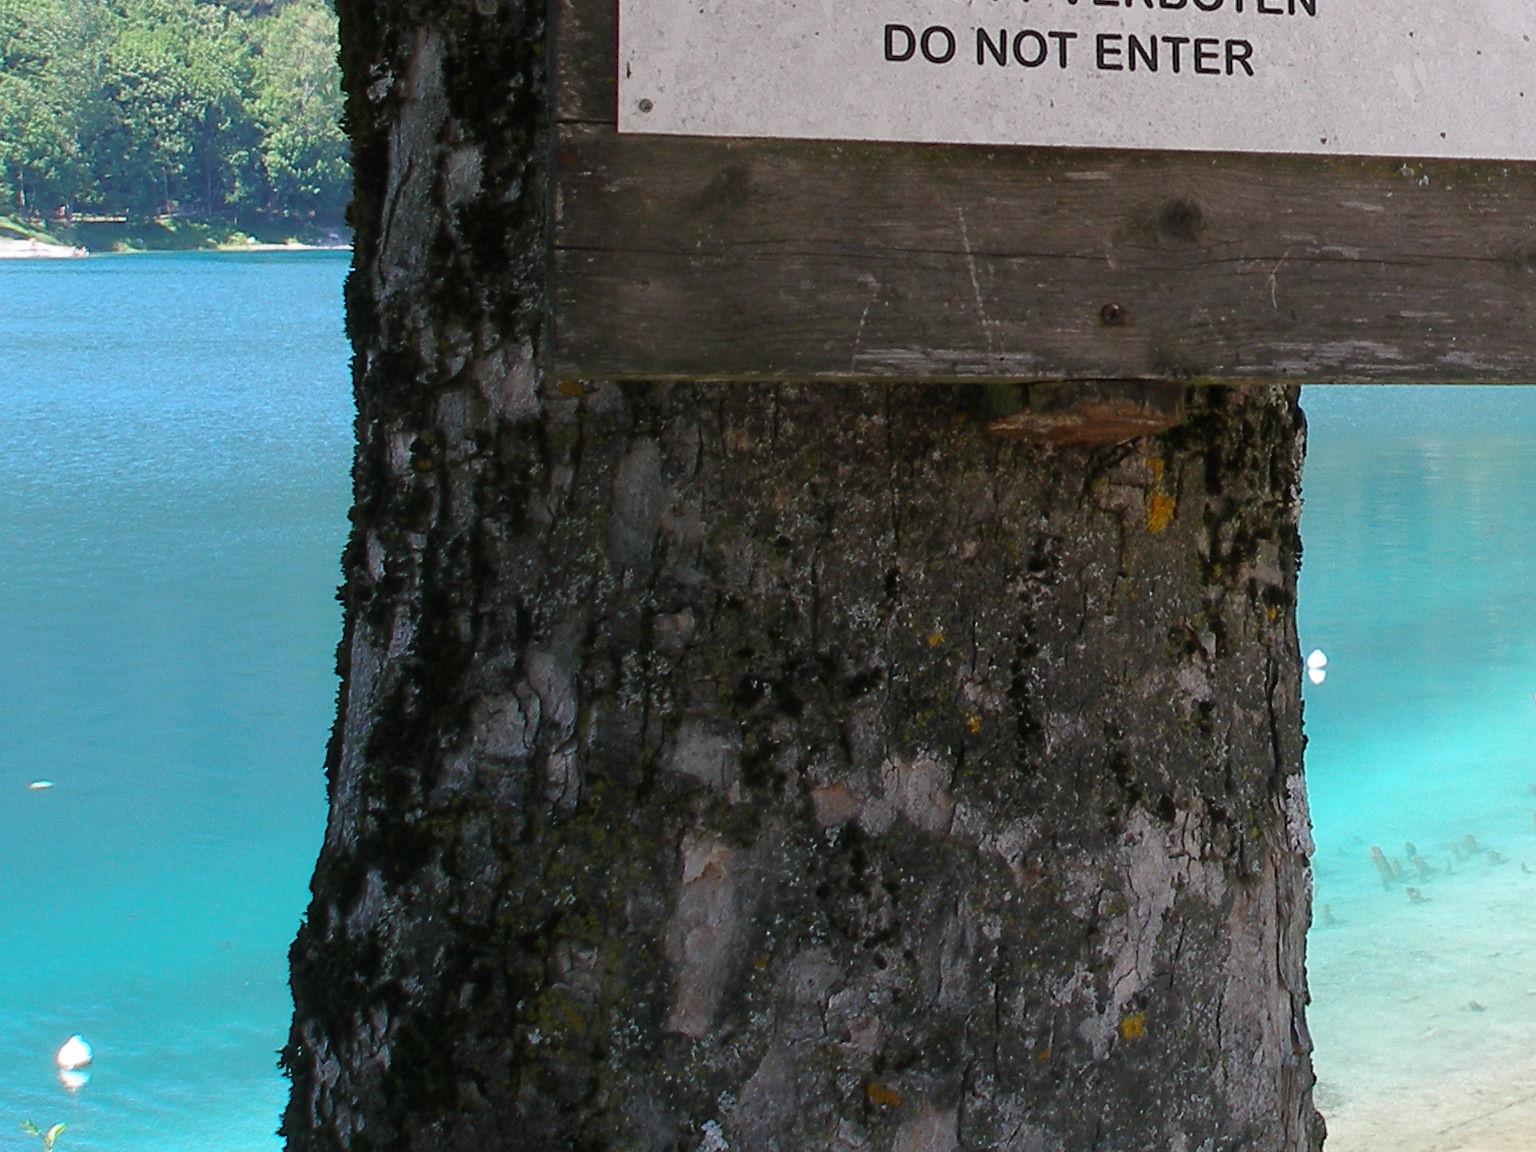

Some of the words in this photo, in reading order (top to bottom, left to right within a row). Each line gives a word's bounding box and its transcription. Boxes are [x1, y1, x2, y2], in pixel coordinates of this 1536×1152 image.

[884, 23, 956, 65] DO
[976, 27, 1078, 69] NOT
[1095, 33, 1255, 77] ENTER
